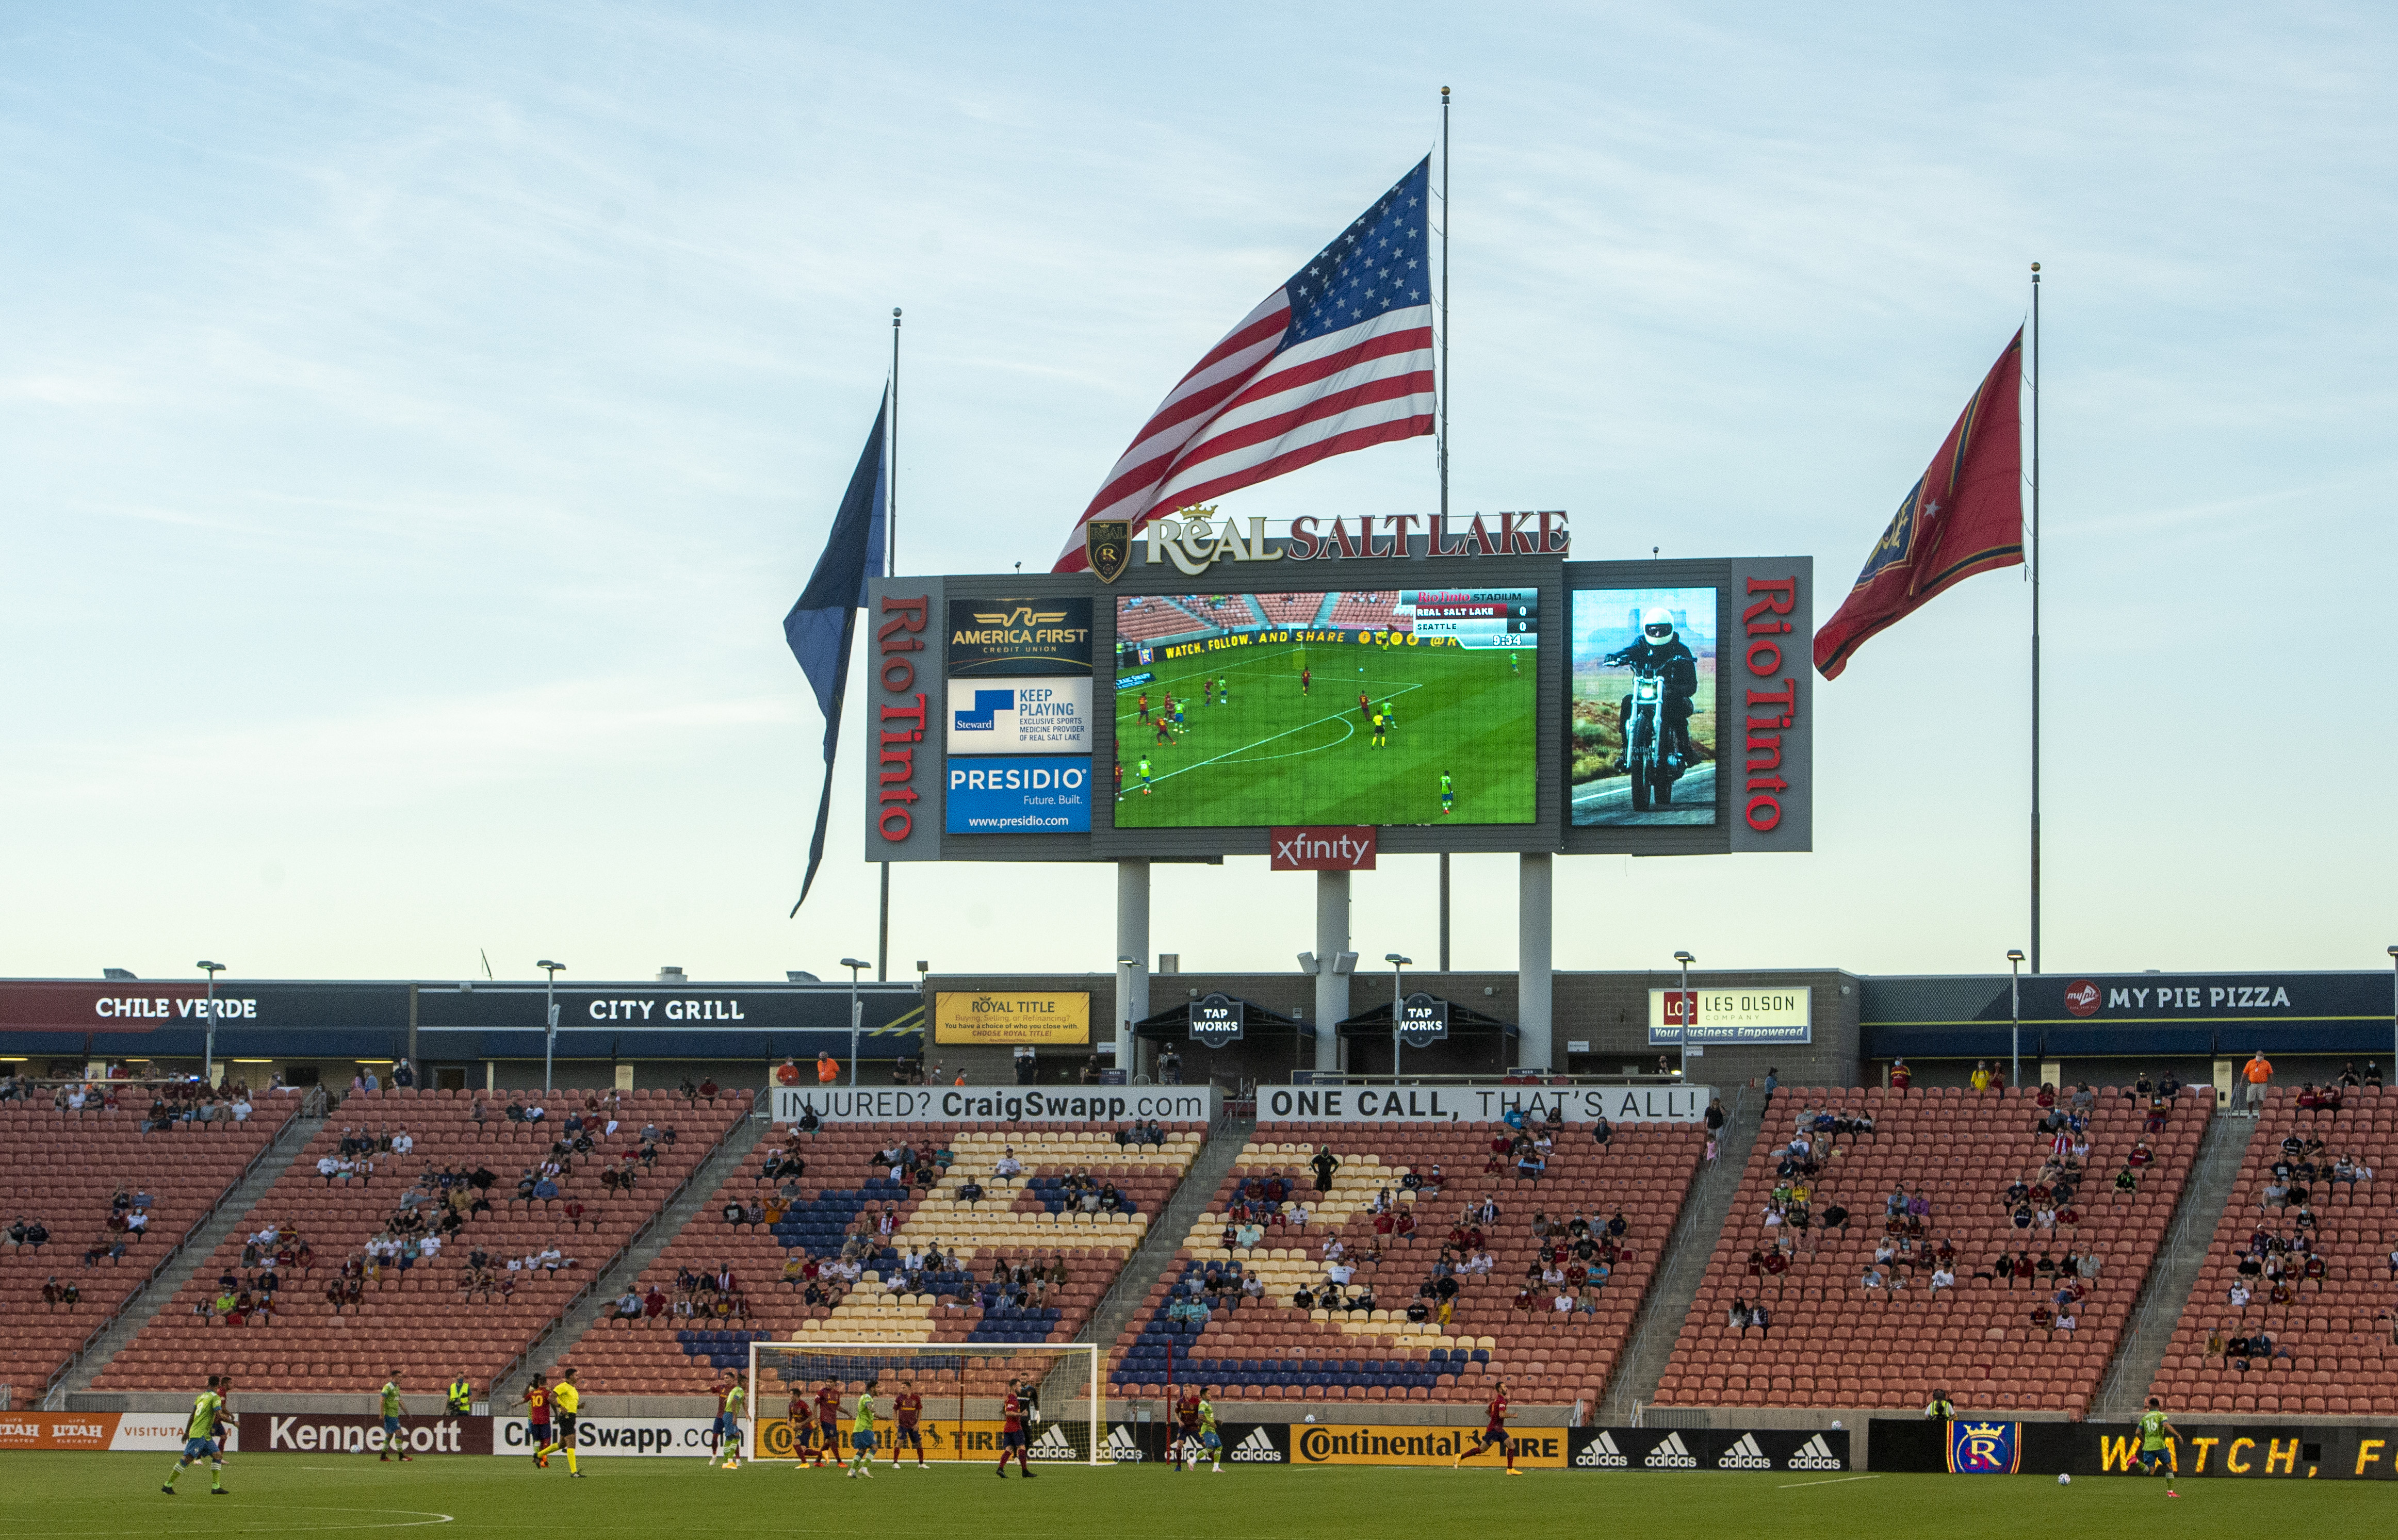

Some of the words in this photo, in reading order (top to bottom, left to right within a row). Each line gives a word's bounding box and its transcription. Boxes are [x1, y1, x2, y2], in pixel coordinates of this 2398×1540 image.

[1287, 513, 1420, 560] SALT
[1426, 510, 1571, 556] LAKE
[1473, 593, 1522, 601] STADIUM
[1519, 606, 1526, 616] 0
[1519, 621, 1526, 632] 0
[952, 630, 1033, 645] AMERICA
[1036, 629, 1088, 643] FIRST
[1259, 631, 1287, 644] AND
[1295, 631, 1345, 642] SHARE
[1493, 635, 1521, 645] 9:34
[1020, 689, 1052, 701] KEEP
[1020, 703, 1074, 716] PLAYING
[957, 720, 992, 729] Steward
[1023, 795, 1056, 805] Future.
[1059, 795, 1082, 804] Built.
[969, 815, 1068, 828] www.presidio.com
[1277, 833, 1369, 865] xfinity
[1706, 997, 1733, 1011] LES
[1741, 996, 1794, 1010] OLSON
[2108, 988, 2150, 1008] MY
[2157, 988, 2201, 1008] PIE
[2210, 987, 2291, 1007] PIZZA
[95, 998, 170, 1018] CHILE
[176, 998, 257, 1018] VERDE
[589, 1001, 655, 1020] CITY
[665, 1000, 744, 1020] GRILL
[972, 1001, 1014, 1013] ROYAL
[1017, 1002, 1055, 1013] TITLE
[1408, 1008, 1432, 1018] TAP
[1203, 1009, 1228, 1019] TAP
[1193, 1021, 1238, 1031] WORKS
[1655, 1028, 1679, 1038] Your
[1686, 1028, 1734, 1038] usiness
[1737, 1027, 1804, 1039] Empowered
[783, 1091, 931, 1117] INJURED?
[942, 1091, 1202, 1122] CraigSwapp.com
[1271, 1090, 1342, 1116] ONE
[1357, 1090, 1459, 1121] CALL,
[1476, 1091, 1603, 1117] THAT'S
[1620, 1092, 1694, 1117] ALL!
[532, 1395, 543, 1407] 10
[195, 1402, 204, 1416] 8
[0, 1424, 40, 1437] TAH
[52, 1424, 103, 1437] UTAH
[2145, 1418, 2157, 1432] 16
[270, 1416, 462, 1452] Kennecott
[1299, 1428, 1461, 1462] Continental
[1027, 1446, 1076, 1459] adidas
[1231, 1446, 1281, 1461] adidas
[1576, 1452, 1628, 1466] adidas
[2355, 1439, 2398, 1476] F
[1645, 1453, 1697, 1467] adidas
[1719, 1454, 1771, 1469] adidas
[1788, 1455, 1841, 1470] adidas
